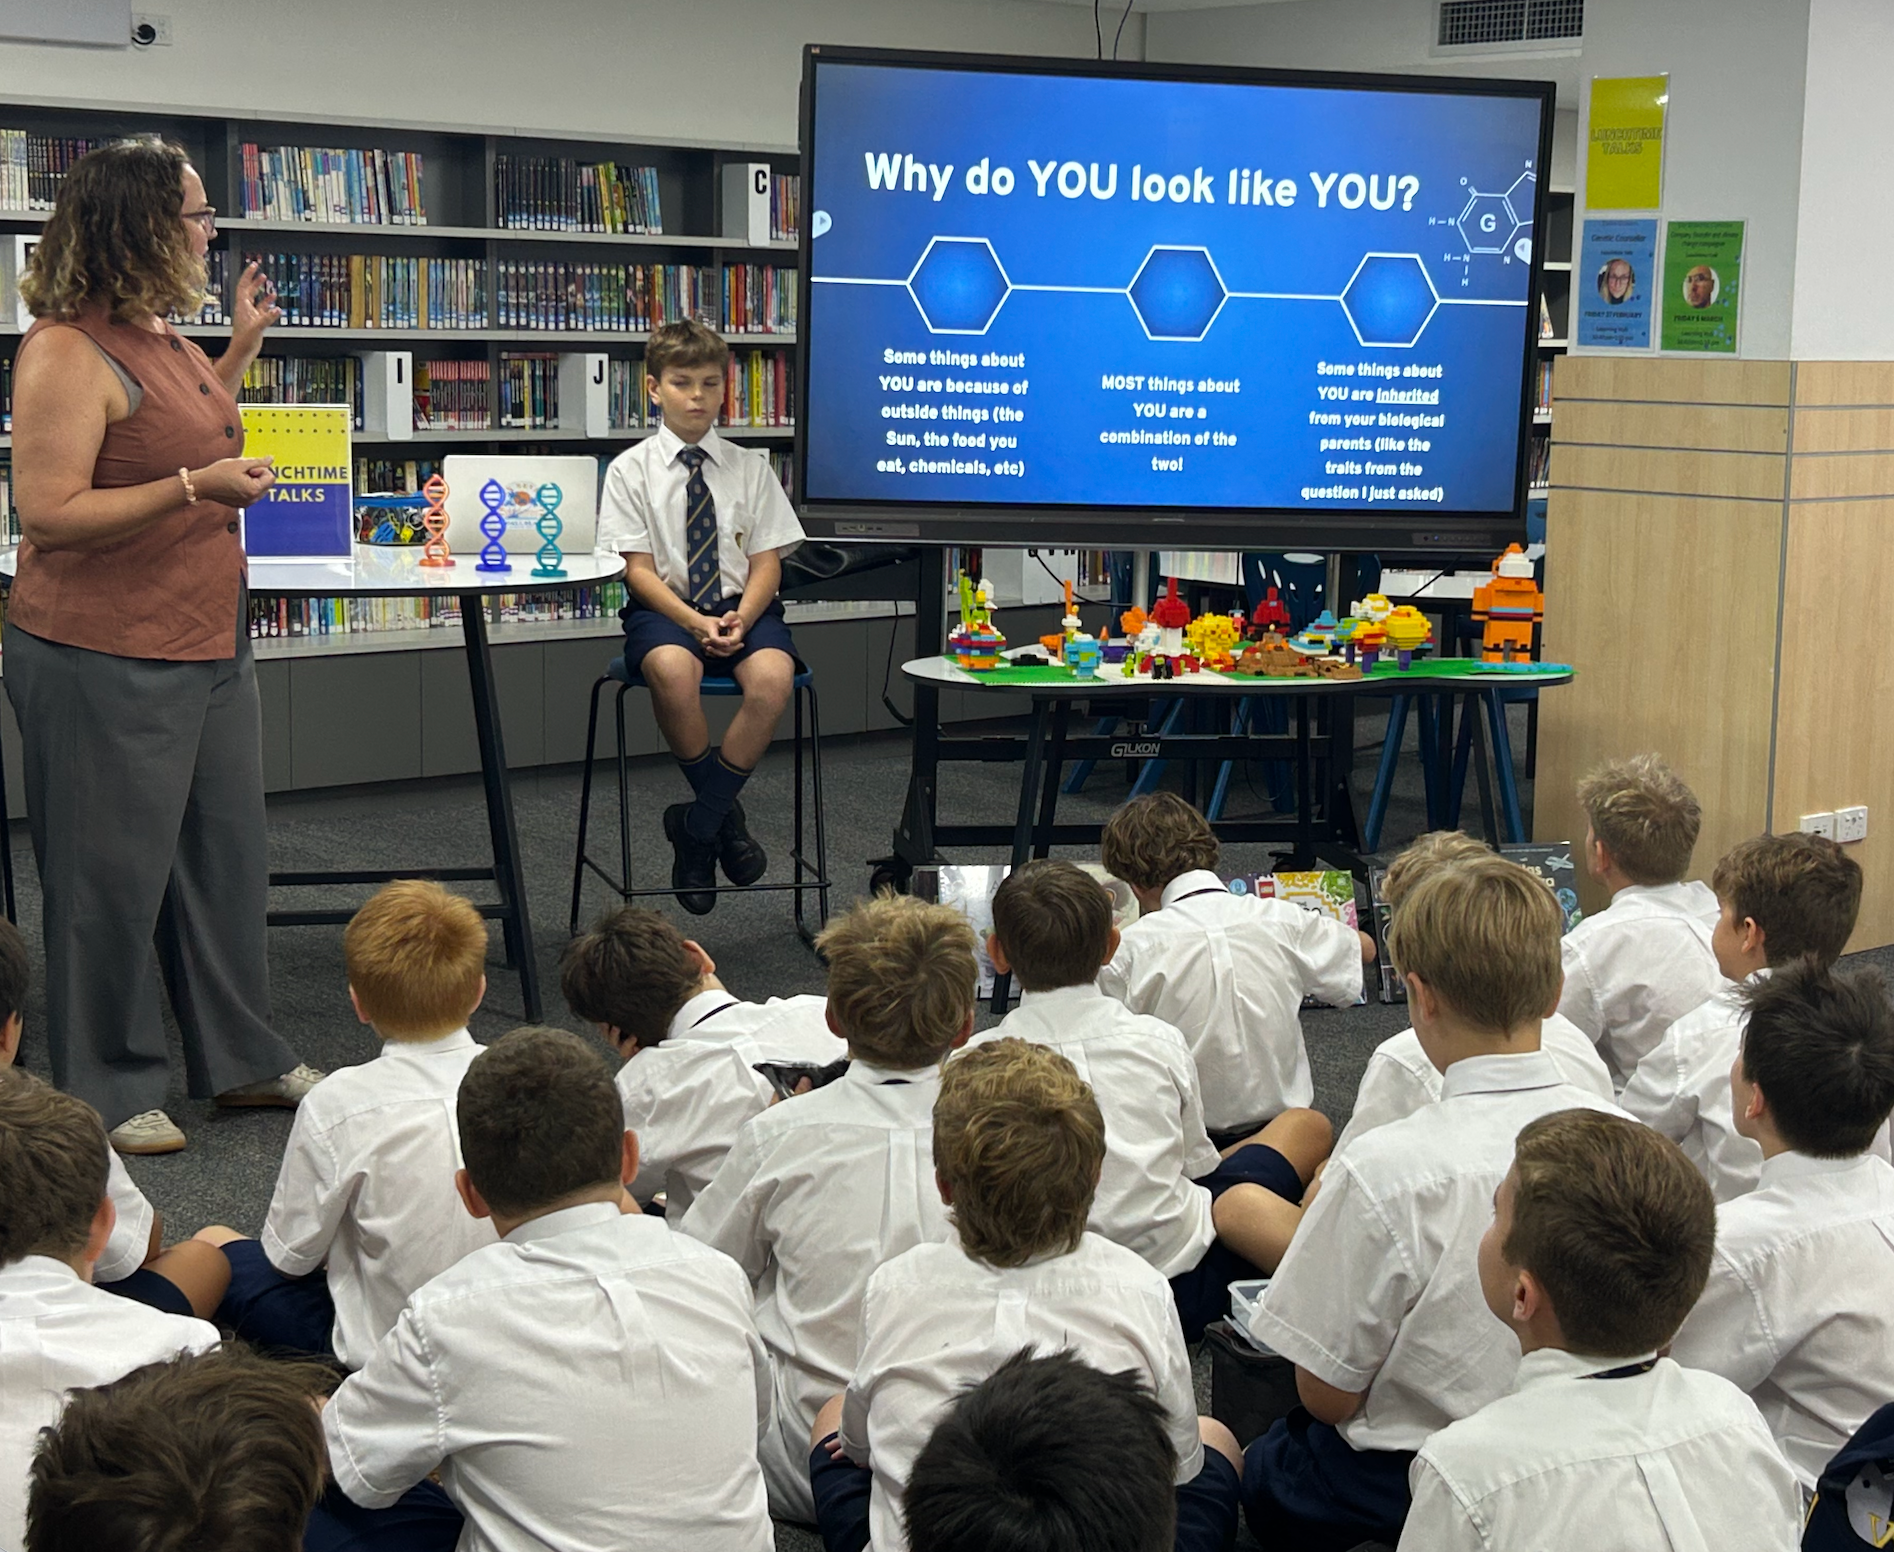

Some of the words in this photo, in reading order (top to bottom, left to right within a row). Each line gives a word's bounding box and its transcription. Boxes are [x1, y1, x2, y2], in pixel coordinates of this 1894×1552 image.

[754, 169, 768, 195] C
[864, 151, 954, 202] Why
[965, 156, 1015, 196] do
[1026, 159, 1118, 200] YOU
[1130, 163, 1215, 205] look
[1228, 167, 1298, 207] like
[1309, 171, 1420, 212] YOU?
[1480, 213, 1497, 233] G
[883, 348, 927, 366] Some
[929, 349, 978, 370] things
[981, 351, 1026, 368] about
[397, 357, 403, 384] I
[593, 359, 604, 385] J
[1316, 361, 1355, 376] Some
[1357, 362, 1401, 380] things
[1402, 363, 1443, 378] about
[878, 375, 914, 392] YOU
[917, 379, 943, 393] are
[946, 377, 1010, 395] because
[1012, 379, 1029, 396] of
[1101, 374, 1146, 391] MOST
[1148, 376, 1195, 395] things
[1197, 377, 1241, 394] about
[1317, 386, 1349, 401] YOU
[1351, 389, 1374, 402] are
[1375, 387, 1439, 404] inherited
[881, 403, 939, 420] outside
[941, 404, 990, 424] things
[993, 405, 1025, 424] (the
[1132, 402, 1167, 418] YOU
[1169, 406, 1194, 419] are
[1197, 407, 1207, 419] a
[1309, 410, 1342, 425] from
[1344, 413, 1376, 428] your
[1378, 412, 1446, 430] biological
[885, 430, 921, 448] Sun,
[923, 431, 950, 447] the
[952, 432, 986, 448] food
[989, 435, 1018, 452] you
[1099, 429, 1191, 445] combination
[1194, 431, 1210, 446] of
[1212, 431, 1238, 447] the
[1319, 436, 1372, 452] parents
[1374, 436, 1406, 452] (like
[1408, 437, 1431, 452] the
[268, 466, 348, 479] NCHTIME
[876, 457, 906, 475] eat,
[908, 458, 991, 477] chemicals,
[993, 460, 1025, 478] etc)
[1151, 456, 1184, 472] two!
[1325, 460, 1362, 475] traits
[1364, 461, 1397, 476] from
[1399, 462, 1423, 476] the
[268, 488, 325, 502] TALKS
[1300, 485, 1359, 501] question
[1361, 485, 1368, 499] I
[1368, 485, 1396, 502] just
[1397, 486, 1445, 503] asked)
[1110, 742, 1161, 757] GILKON
